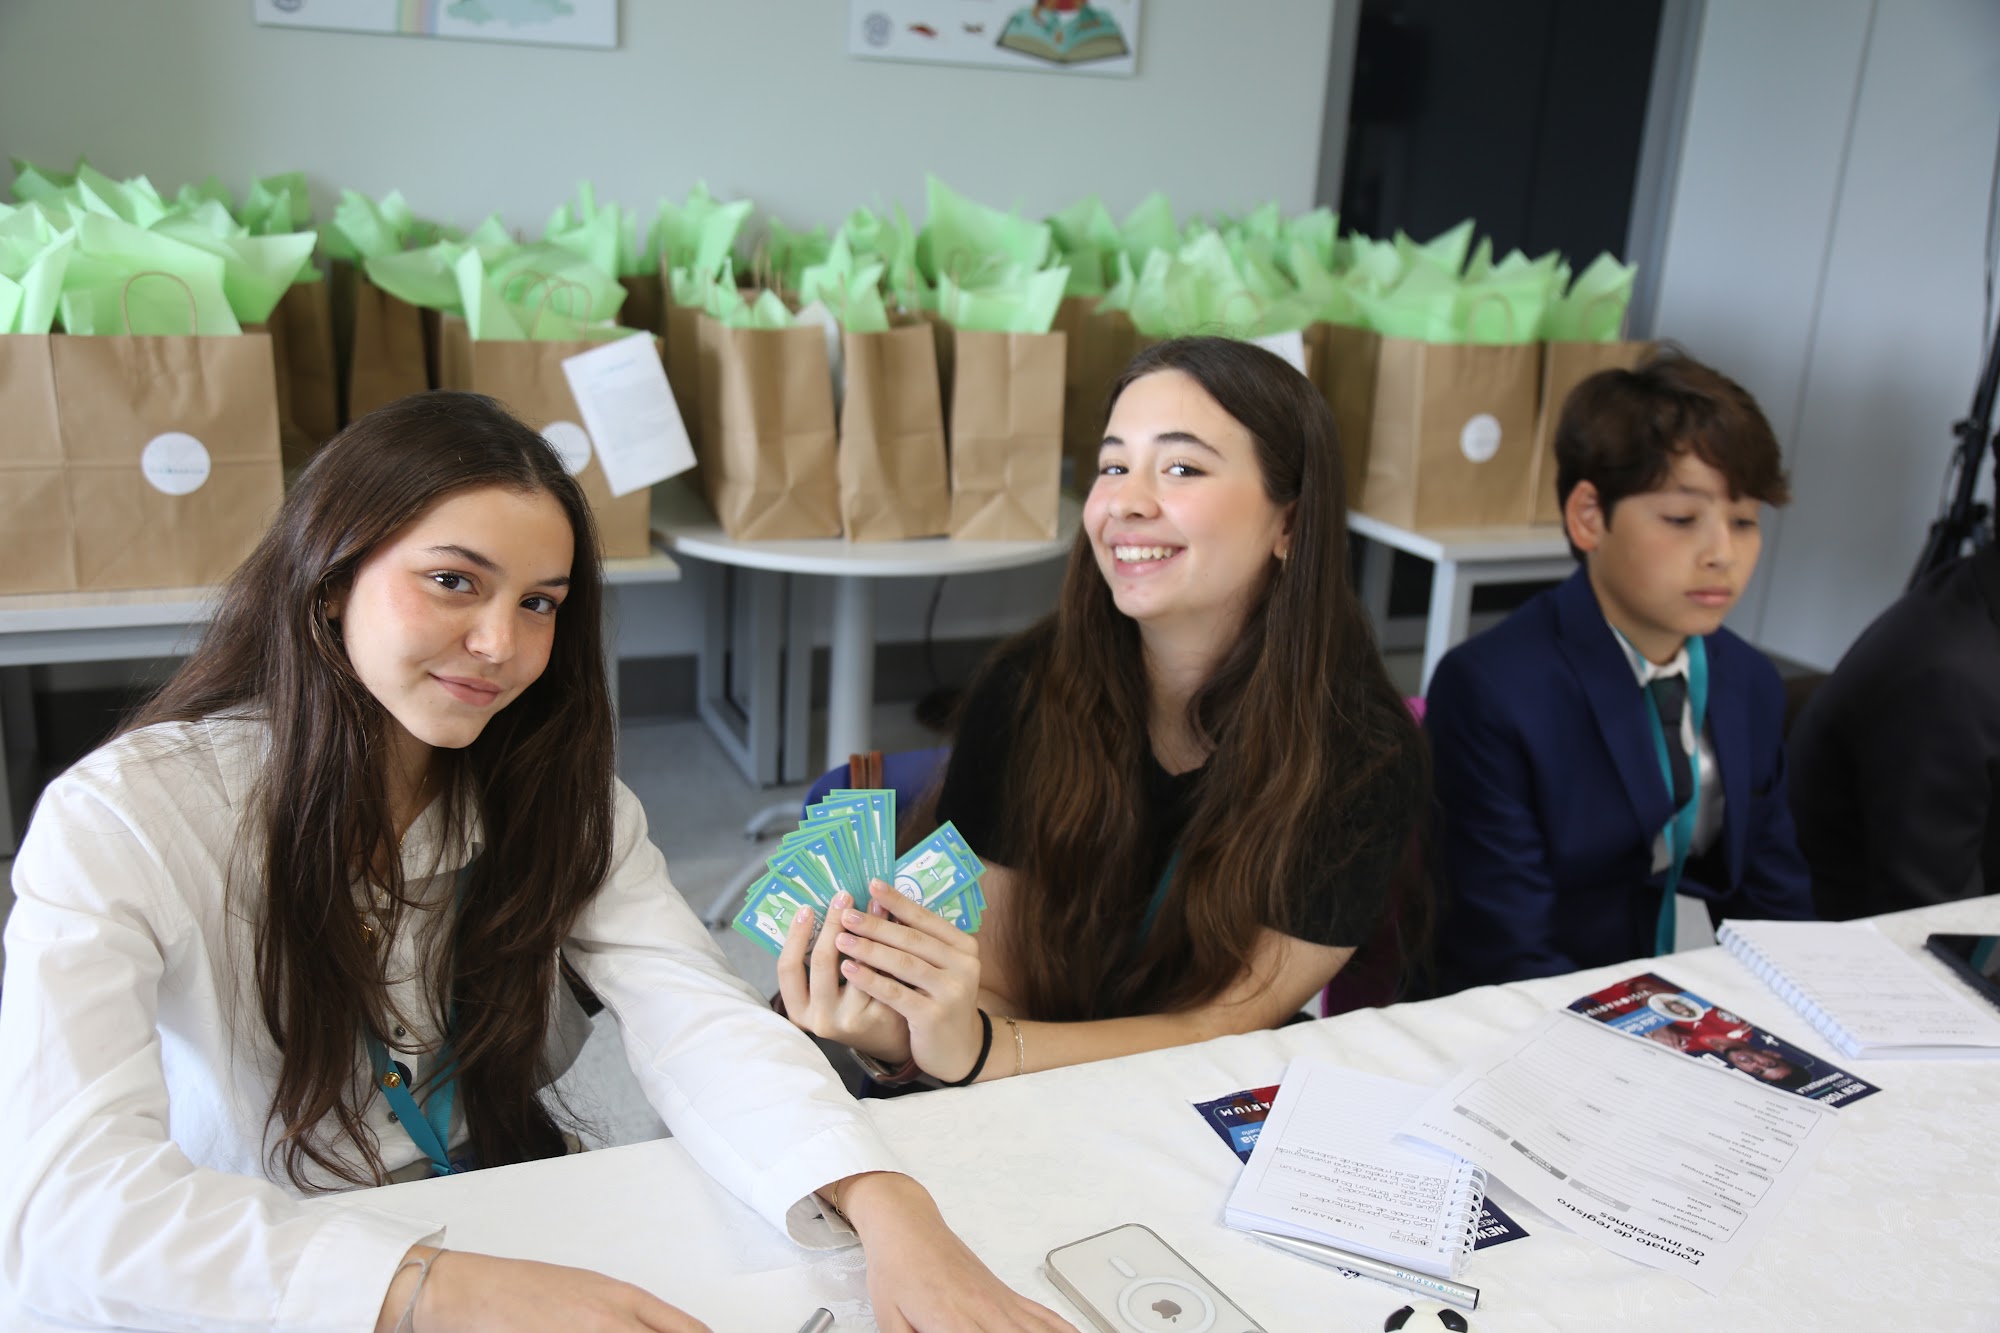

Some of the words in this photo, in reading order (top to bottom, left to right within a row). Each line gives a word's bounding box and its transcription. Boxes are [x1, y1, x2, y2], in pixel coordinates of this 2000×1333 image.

[929, 868, 941, 881] 1
[775, 907, 785, 920] 1
[1841, 1082, 1867, 1096] NEW
[1241, 1134, 1259, 1144] cía
[1422, 1122, 1493, 1160] VISIONARIUM
[1352, 1161, 1391, 1174] mercado
[1401, 1189, 1442, 1200] mercado
[1312, 1196, 1355, 1210] entender
[1337, 1197, 1372, 1209] valores
[1291, 1207, 1364, 1230] VISIONARIUM
[1358, 1208, 1380, 1217] para
[1391, 1211, 1435, 1223] mercado
[1557, 1198, 1610, 1229] registro
[1413, 1221, 1432, 1230] Las
[1658, 1217, 1679, 1227] inicial
[1672, 1214, 1698, 1226] Divisas
[1475, 1224, 1510, 1240] NEW
[1599, 1212, 1682, 1249] inversiones
[1614, 1228, 1632, 1239] de
[1680, 1225, 1714, 1241] Portafolio
[1636, 1237, 1700, 1266] Formato
[1685, 1246, 1705, 1258] de
[1396, 1271, 1464, 1299] VISIONARIUM
